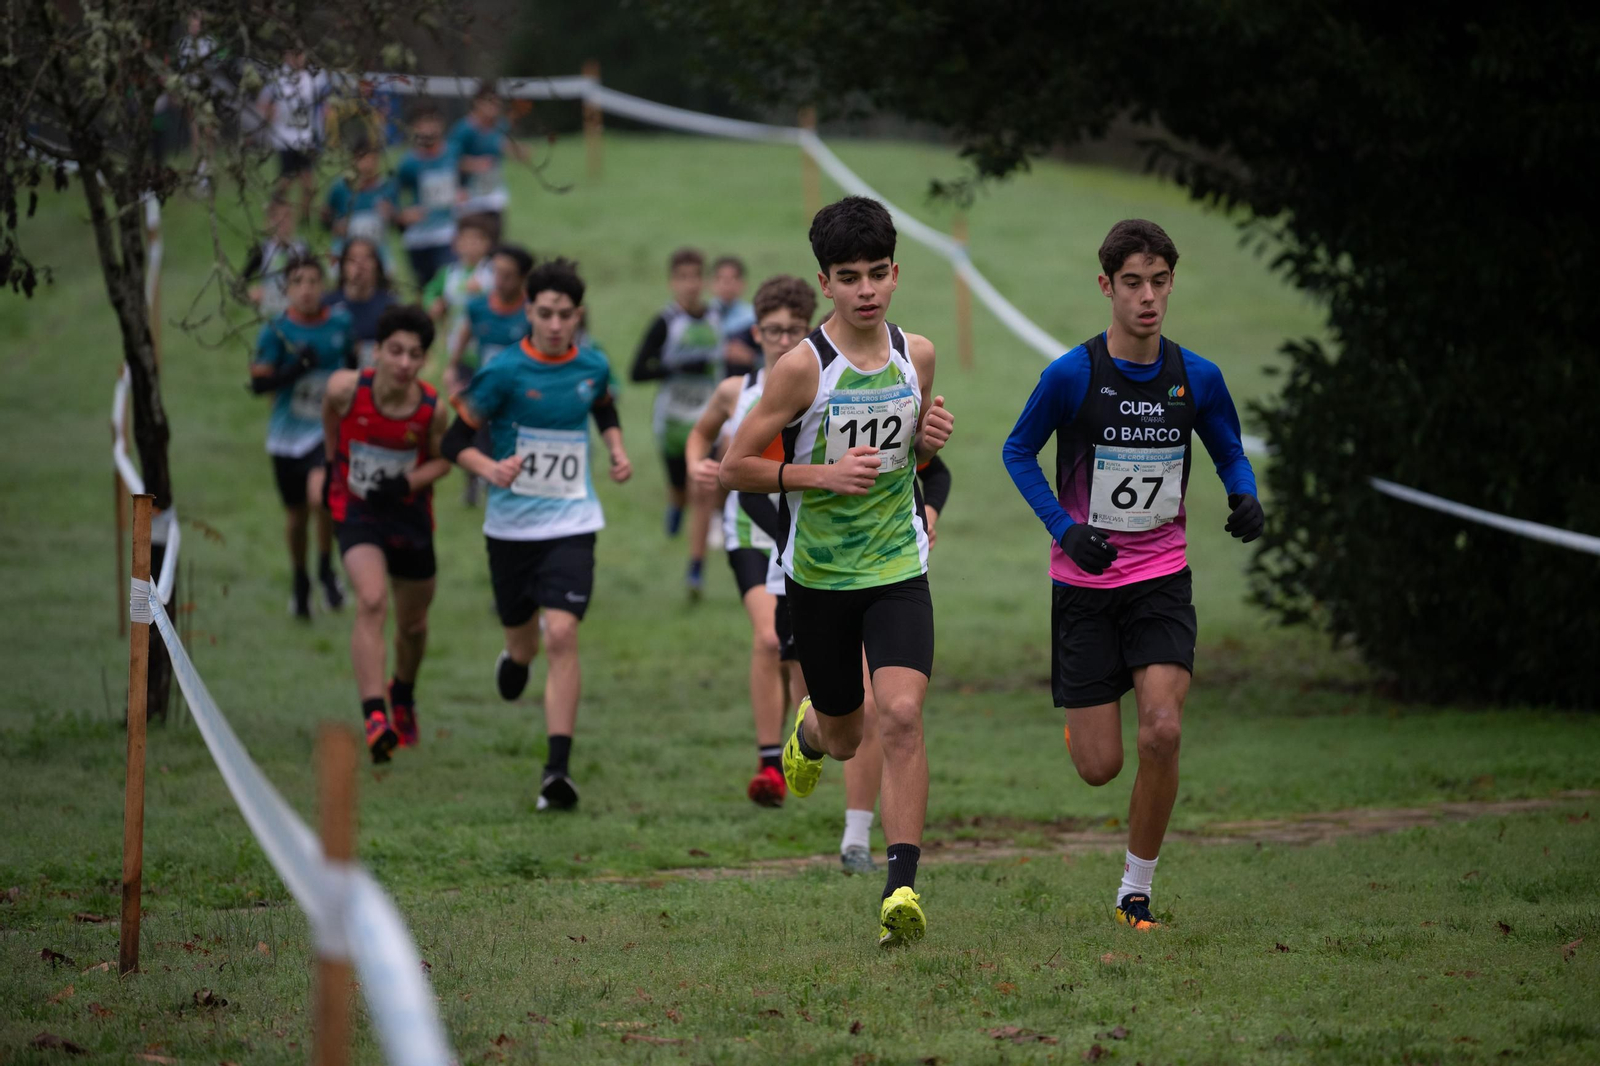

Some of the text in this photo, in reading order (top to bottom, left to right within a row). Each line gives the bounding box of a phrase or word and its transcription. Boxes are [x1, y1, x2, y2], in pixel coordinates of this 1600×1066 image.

[1120, 401, 1165, 416] CUPA
[839, 415, 902, 450] 112
[1104, 427, 1180, 442] O BARCO
[520, 451, 579, 481] 470
[1111, 477, 1164, 510] 67
